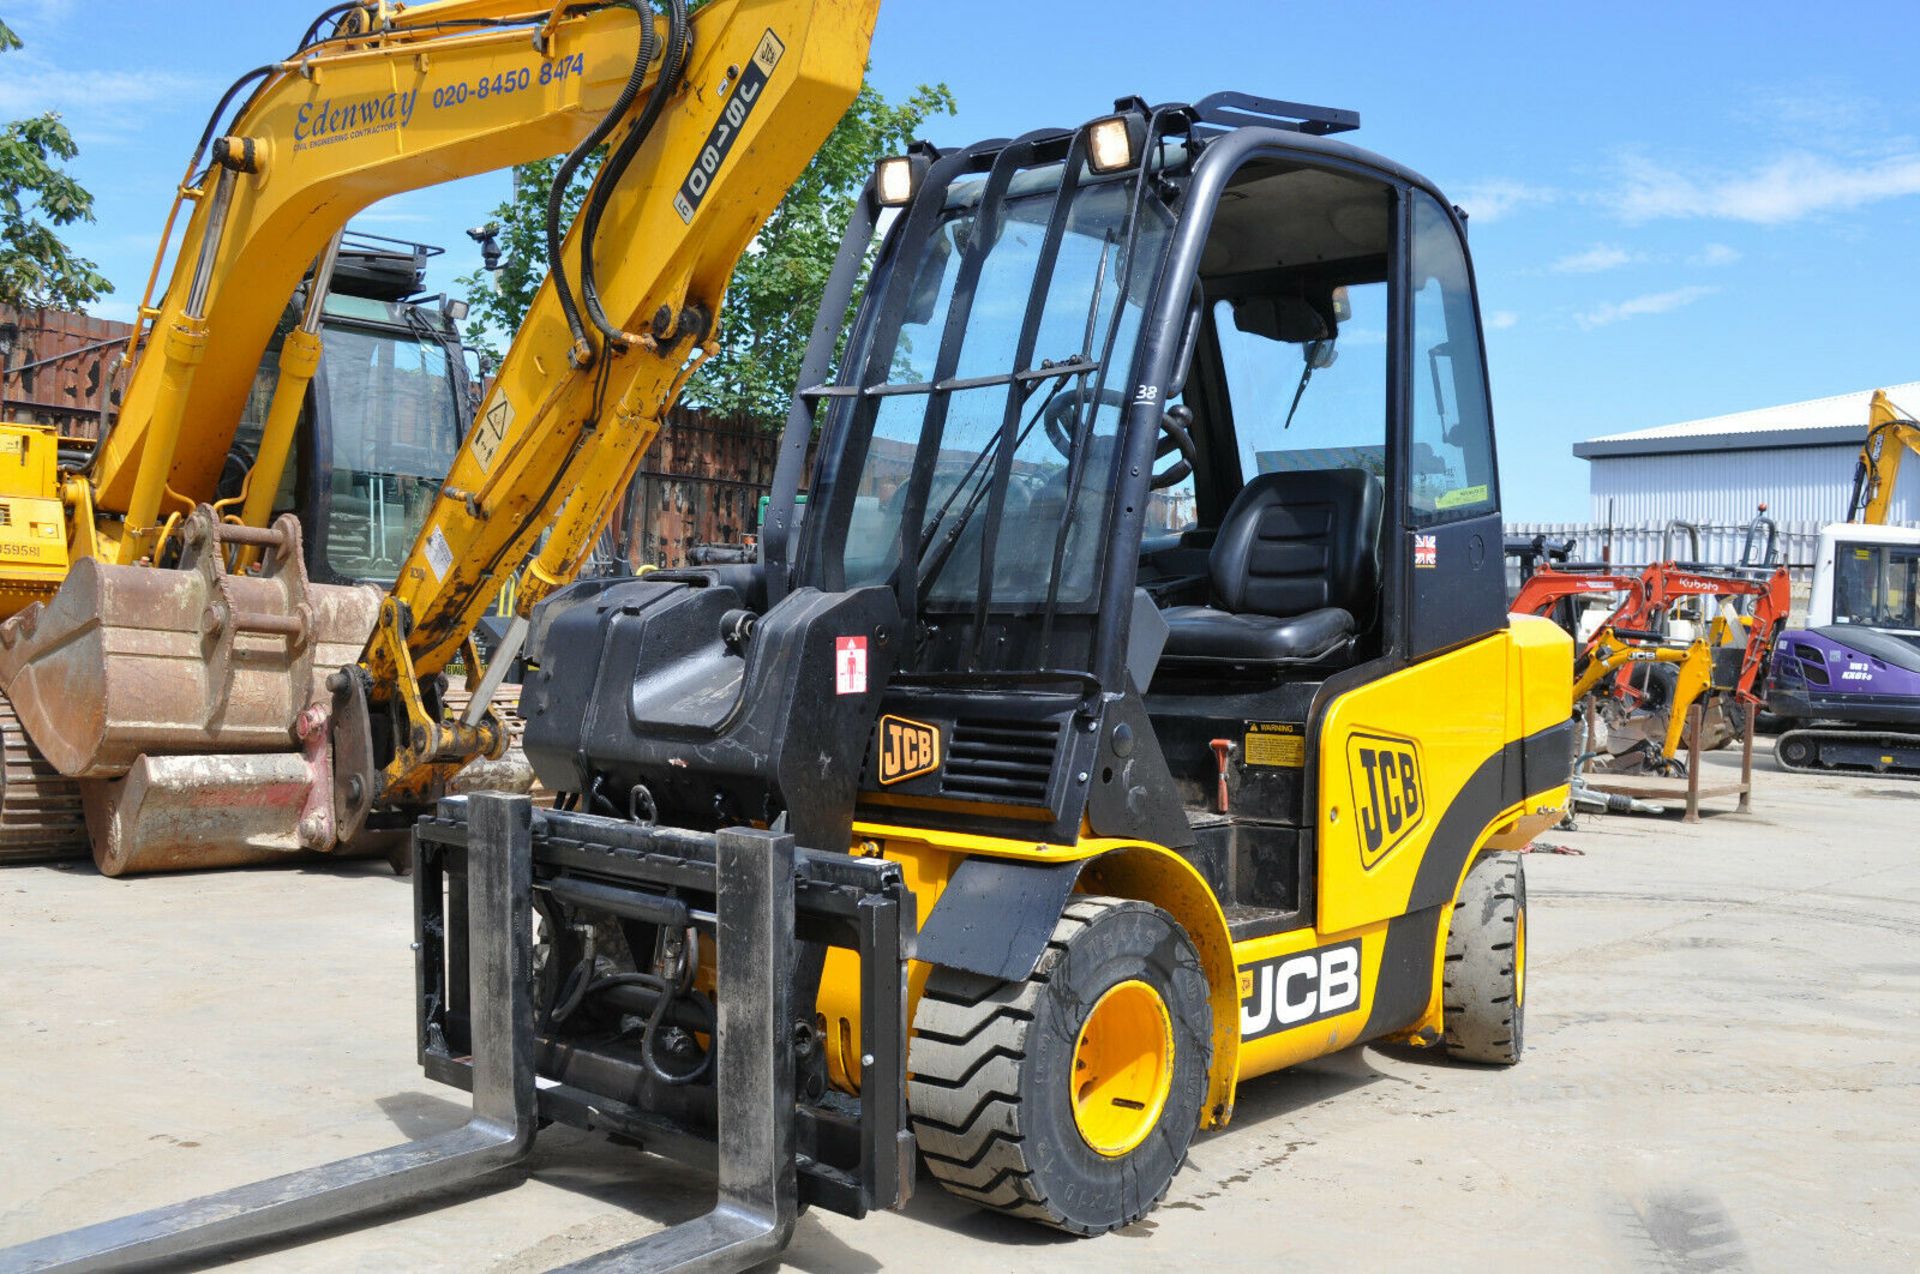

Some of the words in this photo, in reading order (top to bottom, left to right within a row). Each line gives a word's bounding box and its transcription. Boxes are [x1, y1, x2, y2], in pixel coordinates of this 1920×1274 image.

[432, 67, 530, 109] 020-8450
[538, 53, 584, 85] 8474
[293, 88, 417, 141] Edenway
[309, 133, 348, 148] ENGINEERING
[349, 121, 398, 139] CONTRACTORS
[688, 81, 760, 197] JS160
[1135, 384, 1158, 400] 38
[1679, 577, 1719, 591] Kubota
[885, 724, 932, 776] JCB
[1260, 724, 1294, 733] WARNING
[1359, 748, 1418, 853] JCB
[1241, 946, 1359, 1035] JCB
